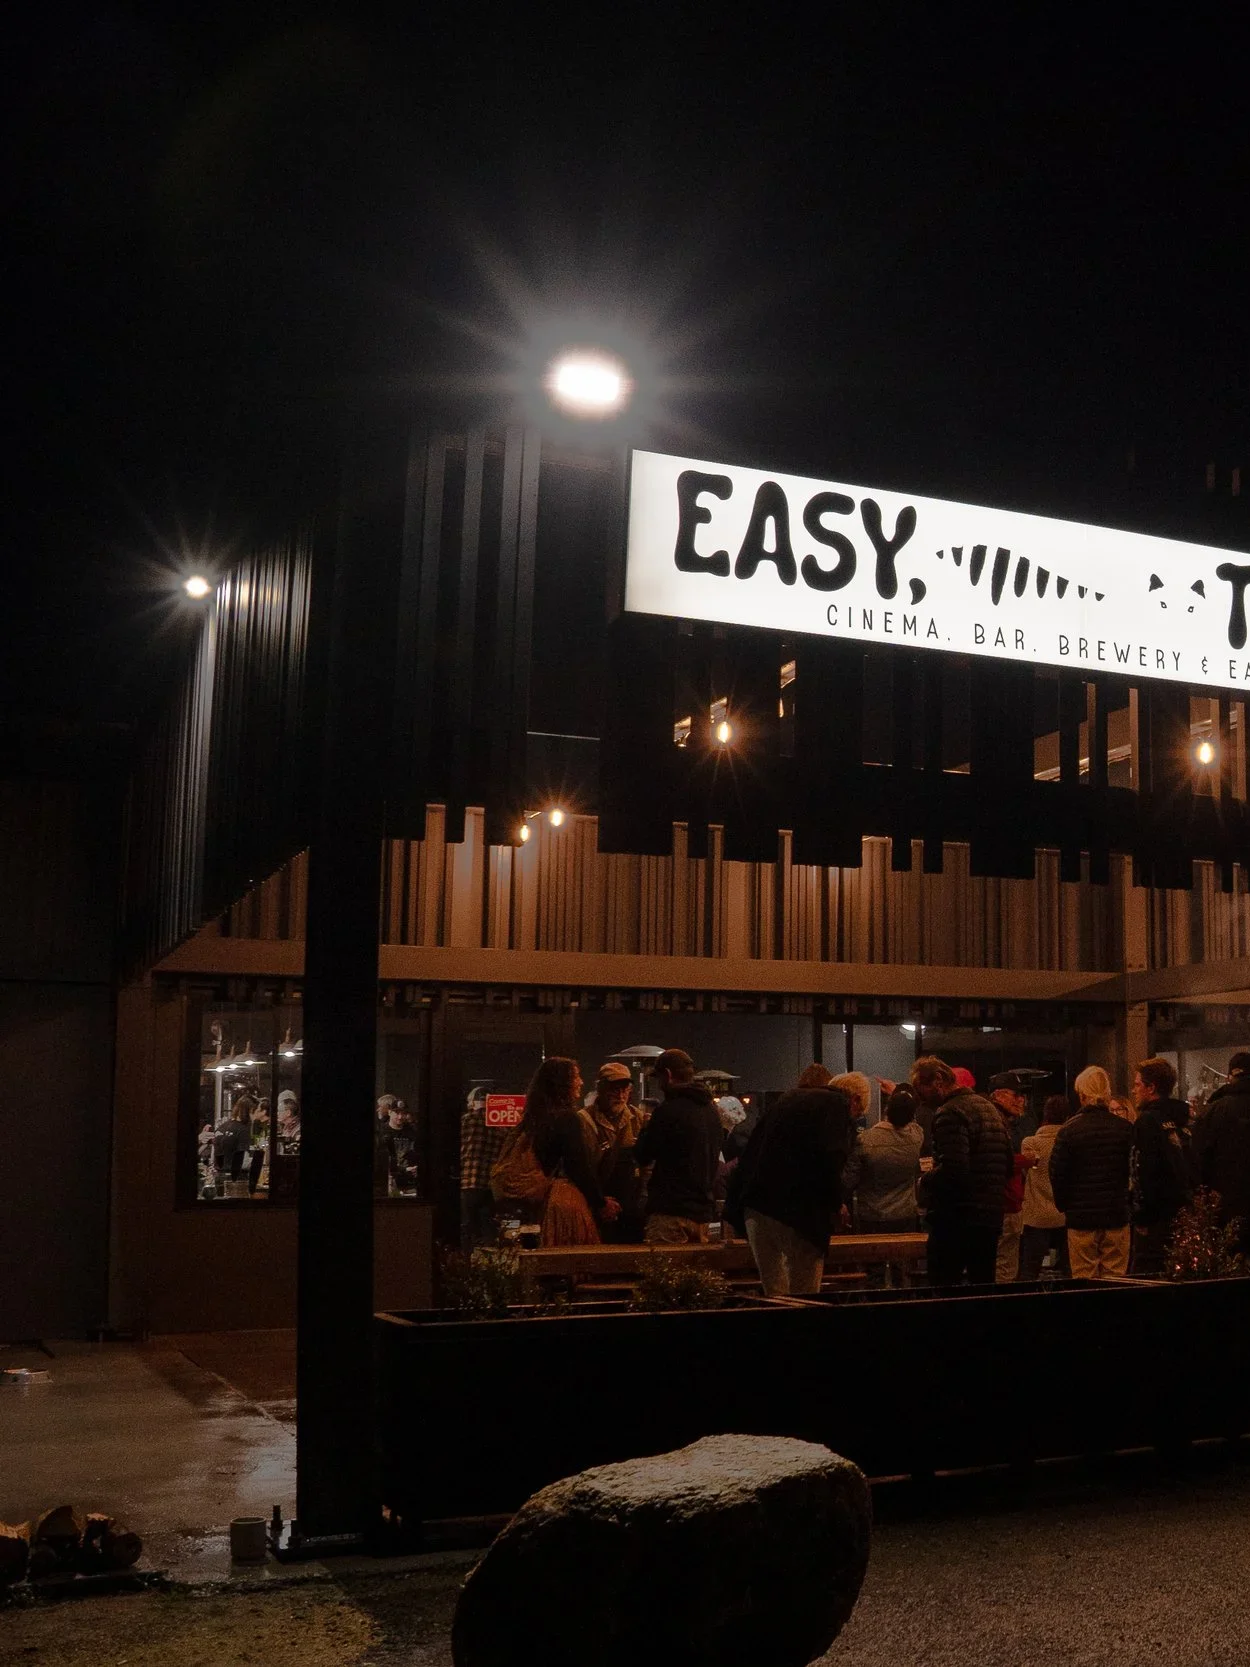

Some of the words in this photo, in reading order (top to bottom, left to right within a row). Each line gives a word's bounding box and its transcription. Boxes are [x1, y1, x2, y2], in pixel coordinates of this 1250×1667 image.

[675, 470, 927, 605] EASY,
[826, 604, 951, 641] CINEMA.
[974, 624, 1037, 652] BAR.
[1059, 635, 1181, 672] BREWERY
